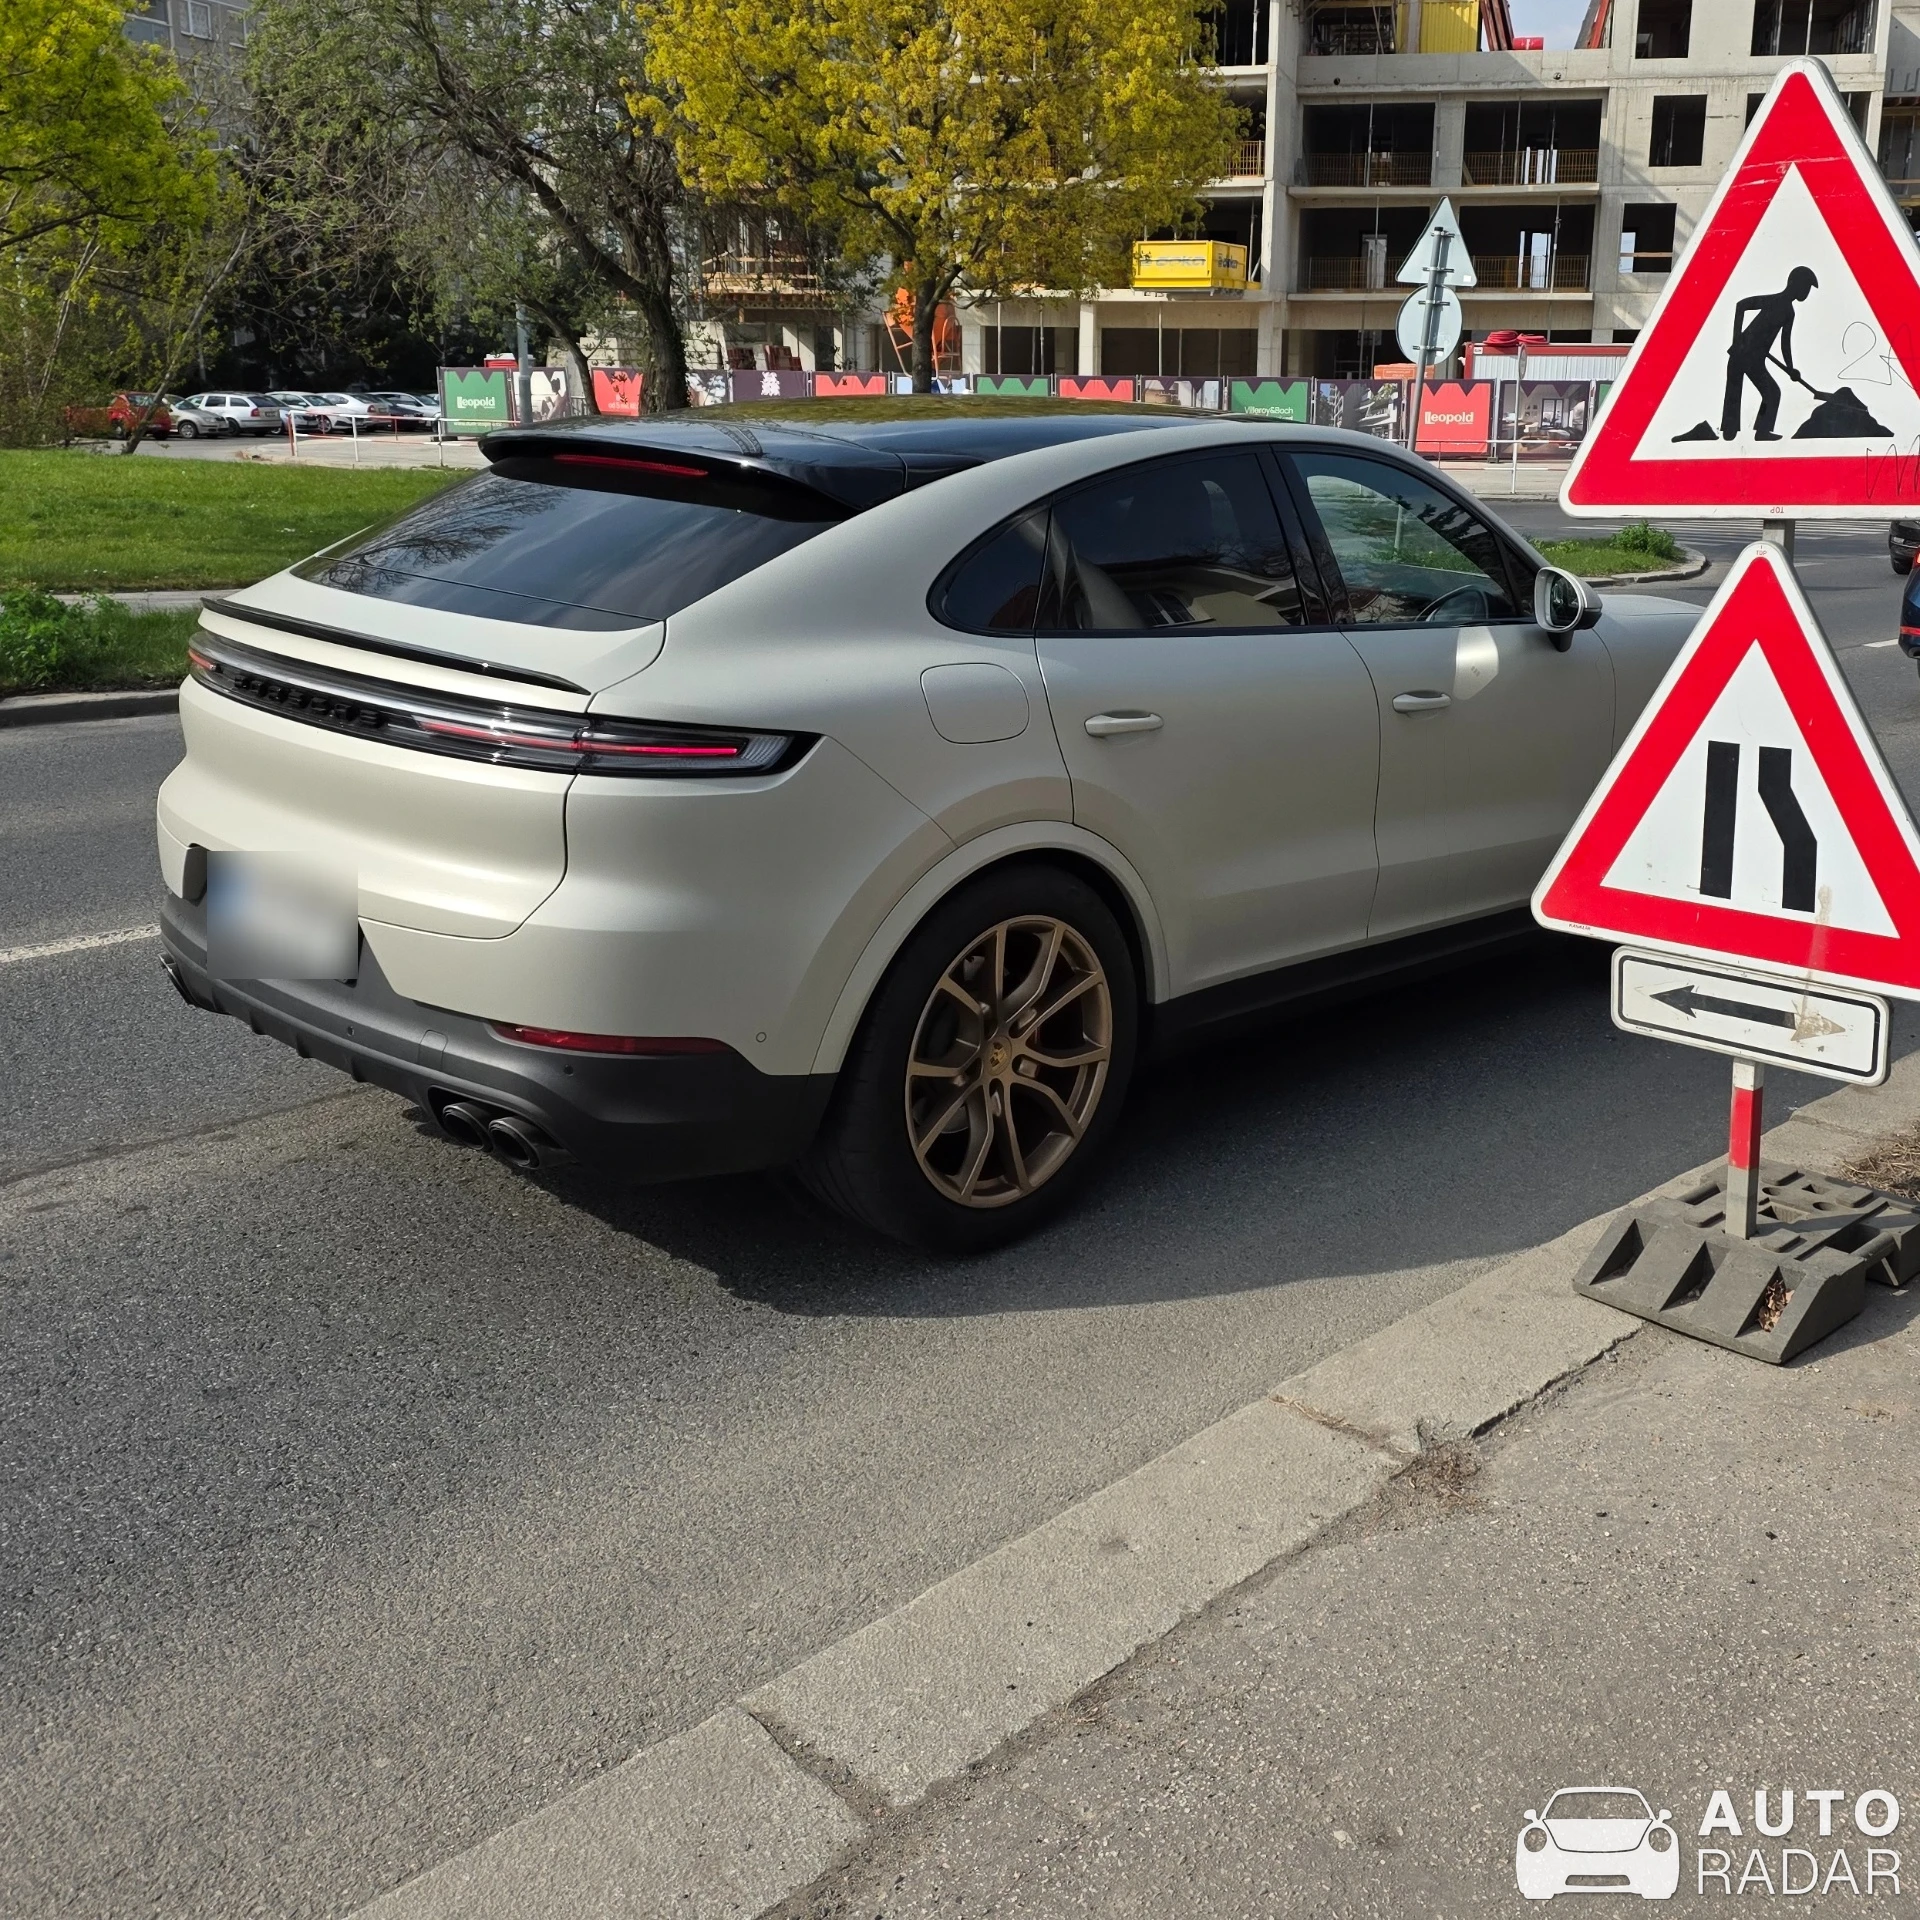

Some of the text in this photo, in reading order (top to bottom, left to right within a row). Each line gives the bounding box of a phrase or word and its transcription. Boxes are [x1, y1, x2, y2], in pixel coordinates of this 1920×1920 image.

[457, 396, 496, 409] Leopold
[1244, 406, 1294, 417] Villeroy&Boch
[1424, 411, 1475, 425] Leopold
[1769, 506, 1785, 514] TOP
